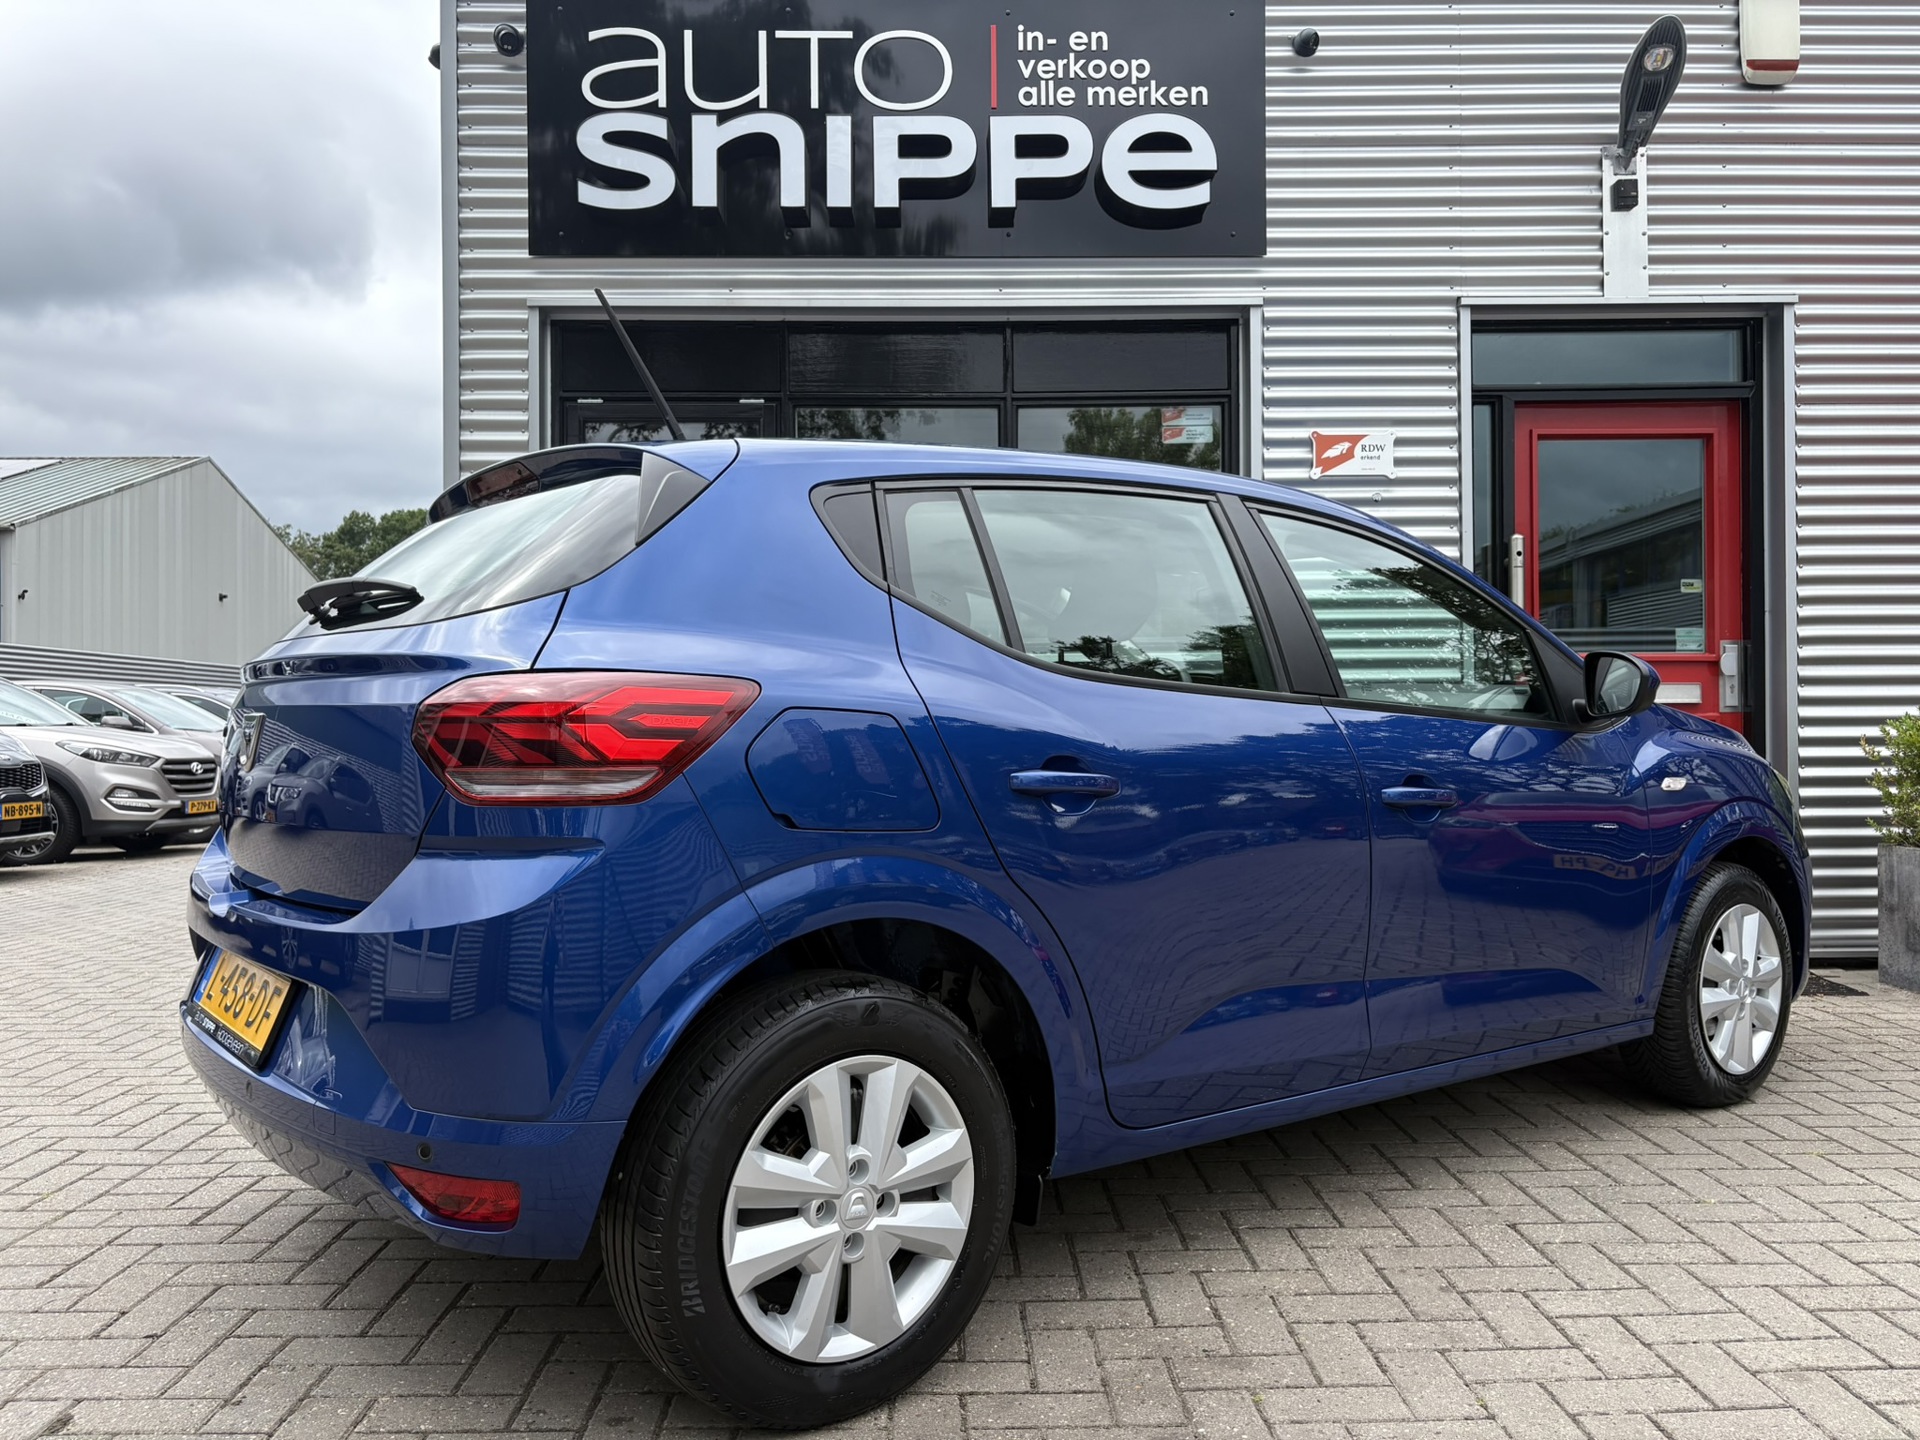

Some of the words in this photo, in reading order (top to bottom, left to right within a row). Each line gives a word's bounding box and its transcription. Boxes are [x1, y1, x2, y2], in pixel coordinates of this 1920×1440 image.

[1017, 24, 1058, 51] in-
[1068, 30, 1109, 51] en
[1017, 53, 1151, 86] verkoop
[1017, 81, 1082, 107] alle
[1087, 82, 1209, 107] merken
[1360, 444, 1386, 453] RDW
[3, 802, 42, 818] NB-895-N
[206, 955, 282, 1034] L-458-DF
[677, 1138, 713, 1317] BRIDGESTONE
